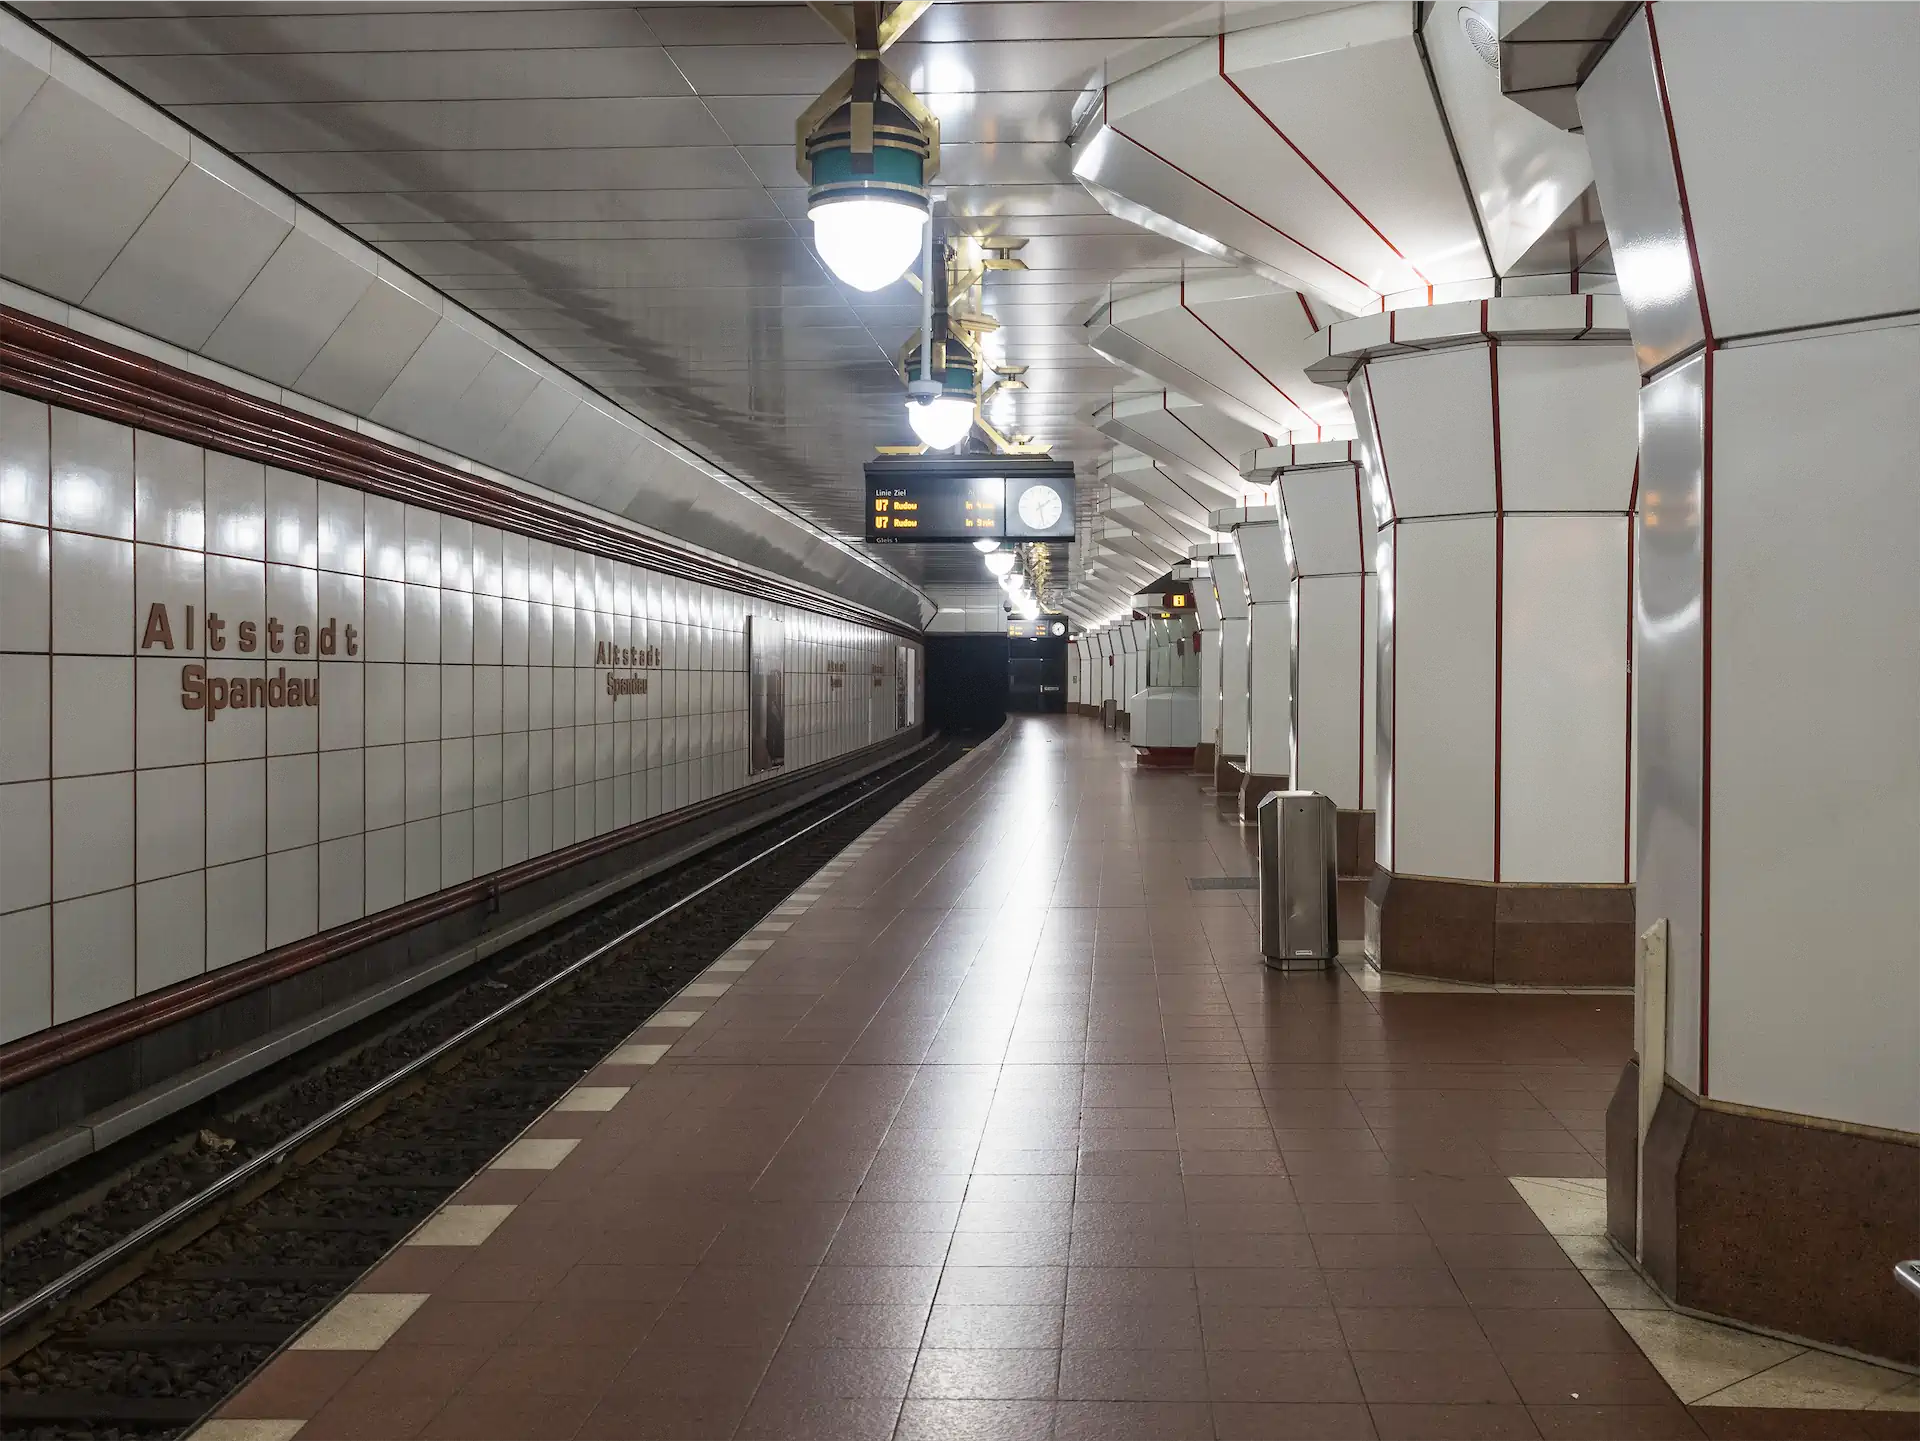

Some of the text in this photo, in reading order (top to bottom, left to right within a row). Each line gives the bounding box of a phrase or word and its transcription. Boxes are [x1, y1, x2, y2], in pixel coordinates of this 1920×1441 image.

[875, 489, 907, 497] Linie Ziel
[875, 498, 889, 512] U7
[893, 501, 918, 511] Rudow
[875, 515, 889, 529] U7
[893, 518, 918, 528] Rudow
[141, 602, 359, 656] Altstadt
[596, 640, 661, 667] Altstadt
[181, 663, 320, 722] Spandau
[606, 671, 648, 702] Spandau
